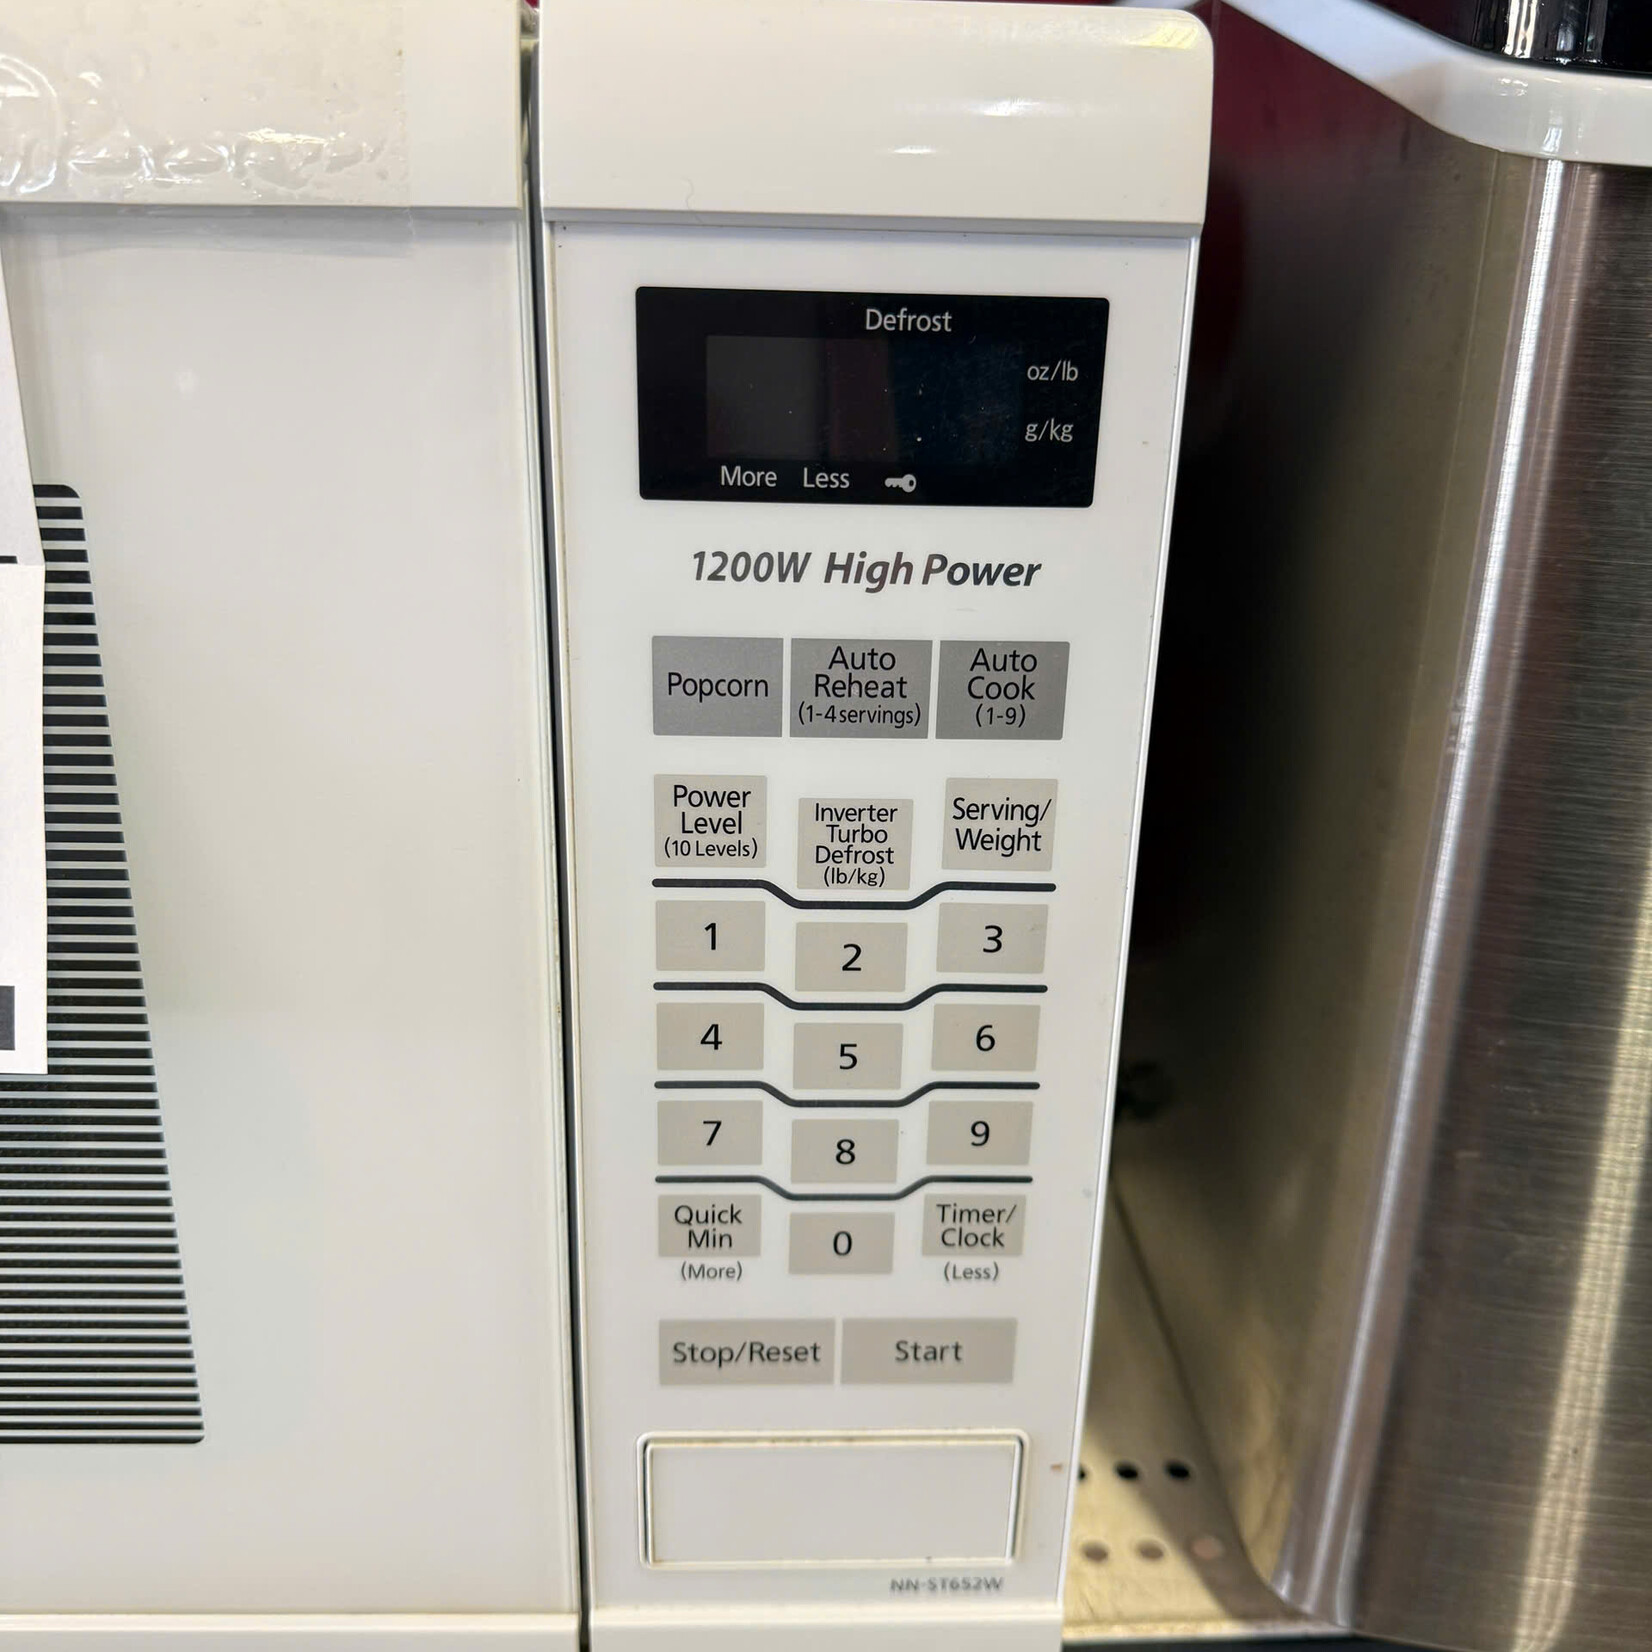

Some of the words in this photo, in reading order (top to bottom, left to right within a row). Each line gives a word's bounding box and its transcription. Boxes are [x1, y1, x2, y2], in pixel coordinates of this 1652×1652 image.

[865, 308, 952, 333] Defrost
[1026, 360, 1079, 383] oz/lb
[1024, 419, 1074, 443] g/kg
[720, 465, 777, 488] More
[802, 467, 850, 489] Less
[692, 551, 812, 583] 1200W
[823, 552, 914, 594] High
[921, 553, 1042, 588] Power
[828, 645, 896, 671] Auto
[969, 648, 1038, 672] Auto
[667, 672, 769, 703] Popcorn
[814, 673, 907, 699] Reheat
[967, 675, 1036, 701] Cook
[975, 705, 1026, 728] (1-9)
[672, 784, 752, 808] Power
[680, 812, 743, 835] Level
[814, 802, 898, 824] Inverter
[952, 797, 1052, 827] Serving/
[826, 824, 888, 844] Turbo
[955, 827, 1042, 858] Weight
[663, 839, 691, 859] (10
[695, 838, 758, 860] Levels)
[814, 844, 895, 865] Defrost
[823, 866, 885, 888] (lb/kg)
[703, 922, 718, 951] 1
[982, 924, 1003, 954] 3
[841, 943, 863, 972] 2
[699, 1023, 723, 1051] 4
[975, 1024, 996, 1052] 6
[839, 1043, 859, 1070] 5
[702, 1120, 723, 1147] 7
[970, 1120, 991, 1147] 9
[835, 1139, 856, 1165] 8
[673, 1203, 742, 1228] Quick
[936, 1203, 1018, 1225] Timer/
[687, 1228, 733, 1249] Min
[832, 1230, 853, 1257] 0
[940, 1226, 1005, 1248] Clock
[680, 1261, 743, 1282] (More)
[943, 1261, 999, 1282] (Less)
[672, 1340, 821, 1369] Stop/Reset
[894, 1340, 963, 1362] Start
[890, 1577, 1004, 1593] NN-ST652W
